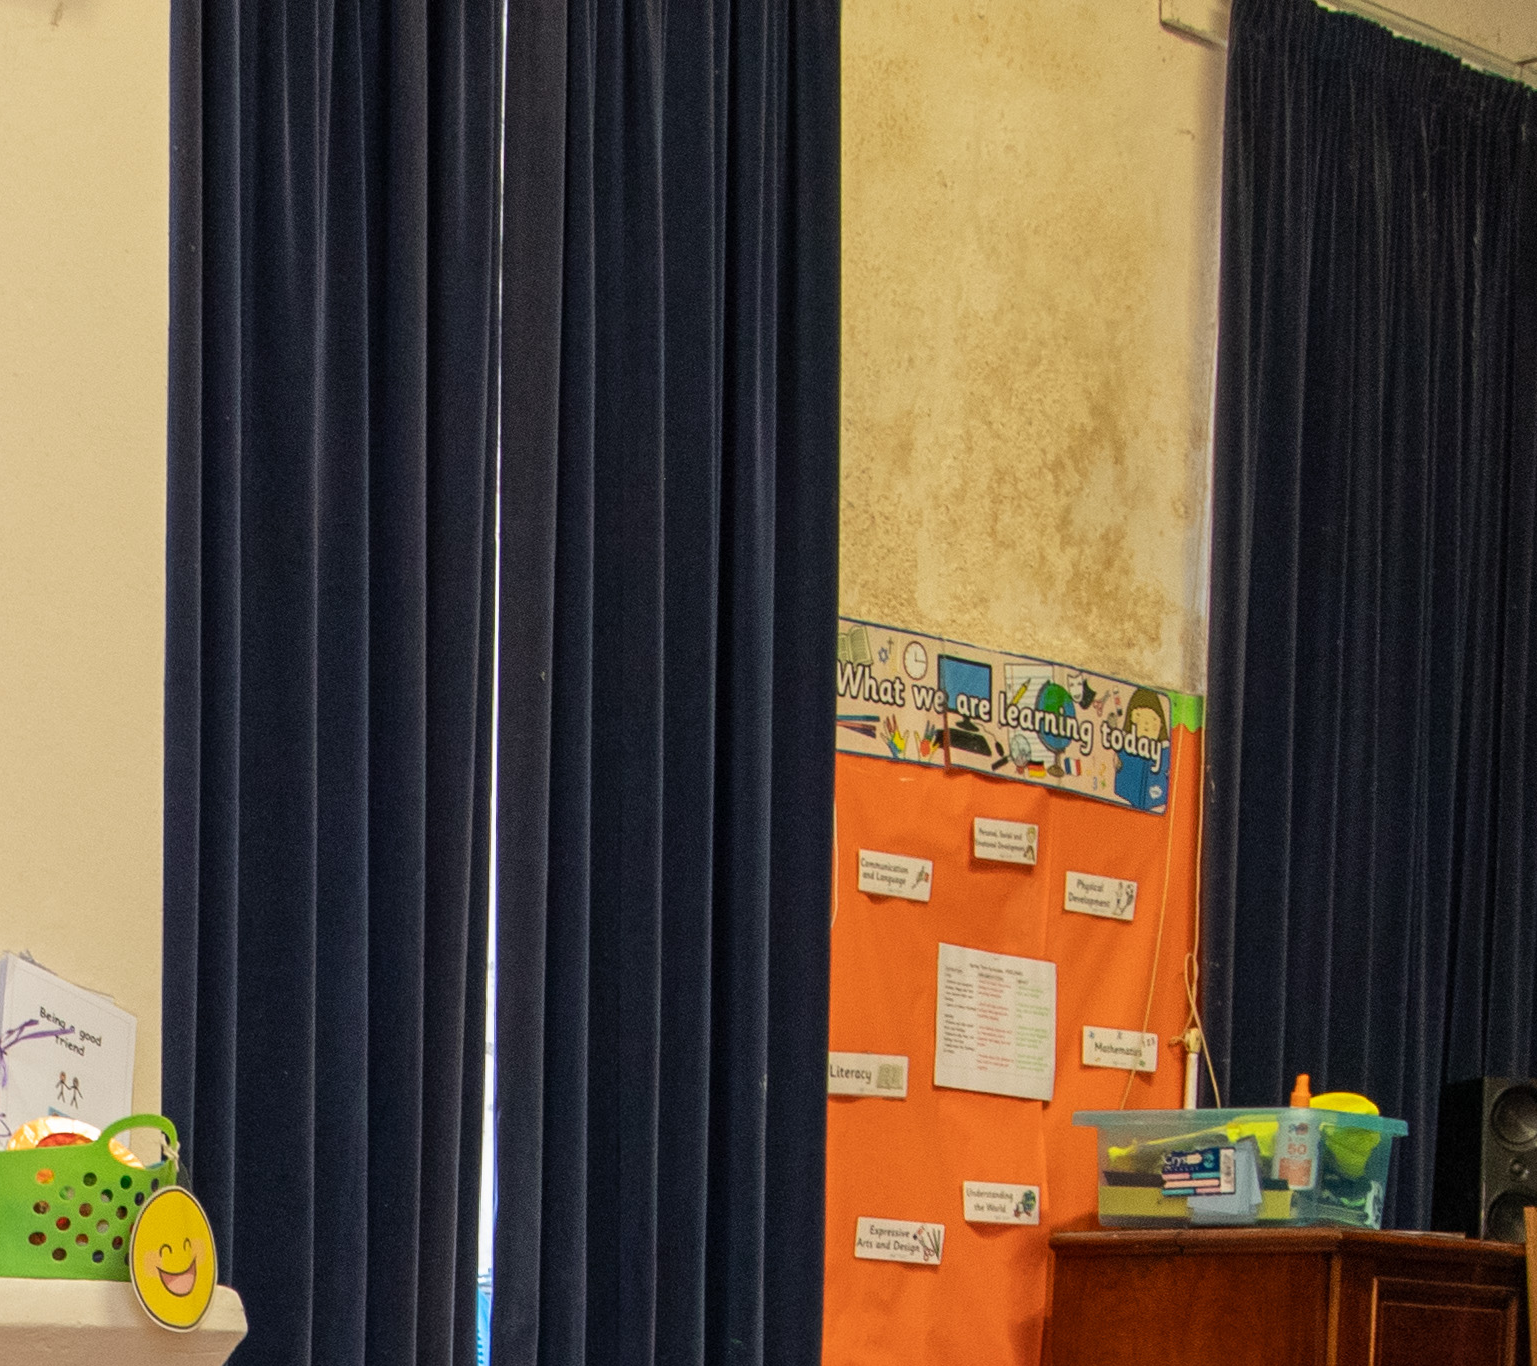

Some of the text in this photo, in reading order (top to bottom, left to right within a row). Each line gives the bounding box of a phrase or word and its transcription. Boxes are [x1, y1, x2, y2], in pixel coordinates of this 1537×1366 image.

[836, 661, 1164, 772] What we are learning today
[860, 858, 909, 875] Communication
[862, 871, 906, 888] and Language
[39, 1006, 66, 1030] Being
[79, 1030, 102, 1047] good
[830, 1064, 872, 1085] Literacy
[966, 1188, 1013, 1203] Understanding
[974, 1203, 1006, 1213] the World
[869, 1224, 910, 1238] Expressive
[857, 1238, 920, 1256] Arts and Design
